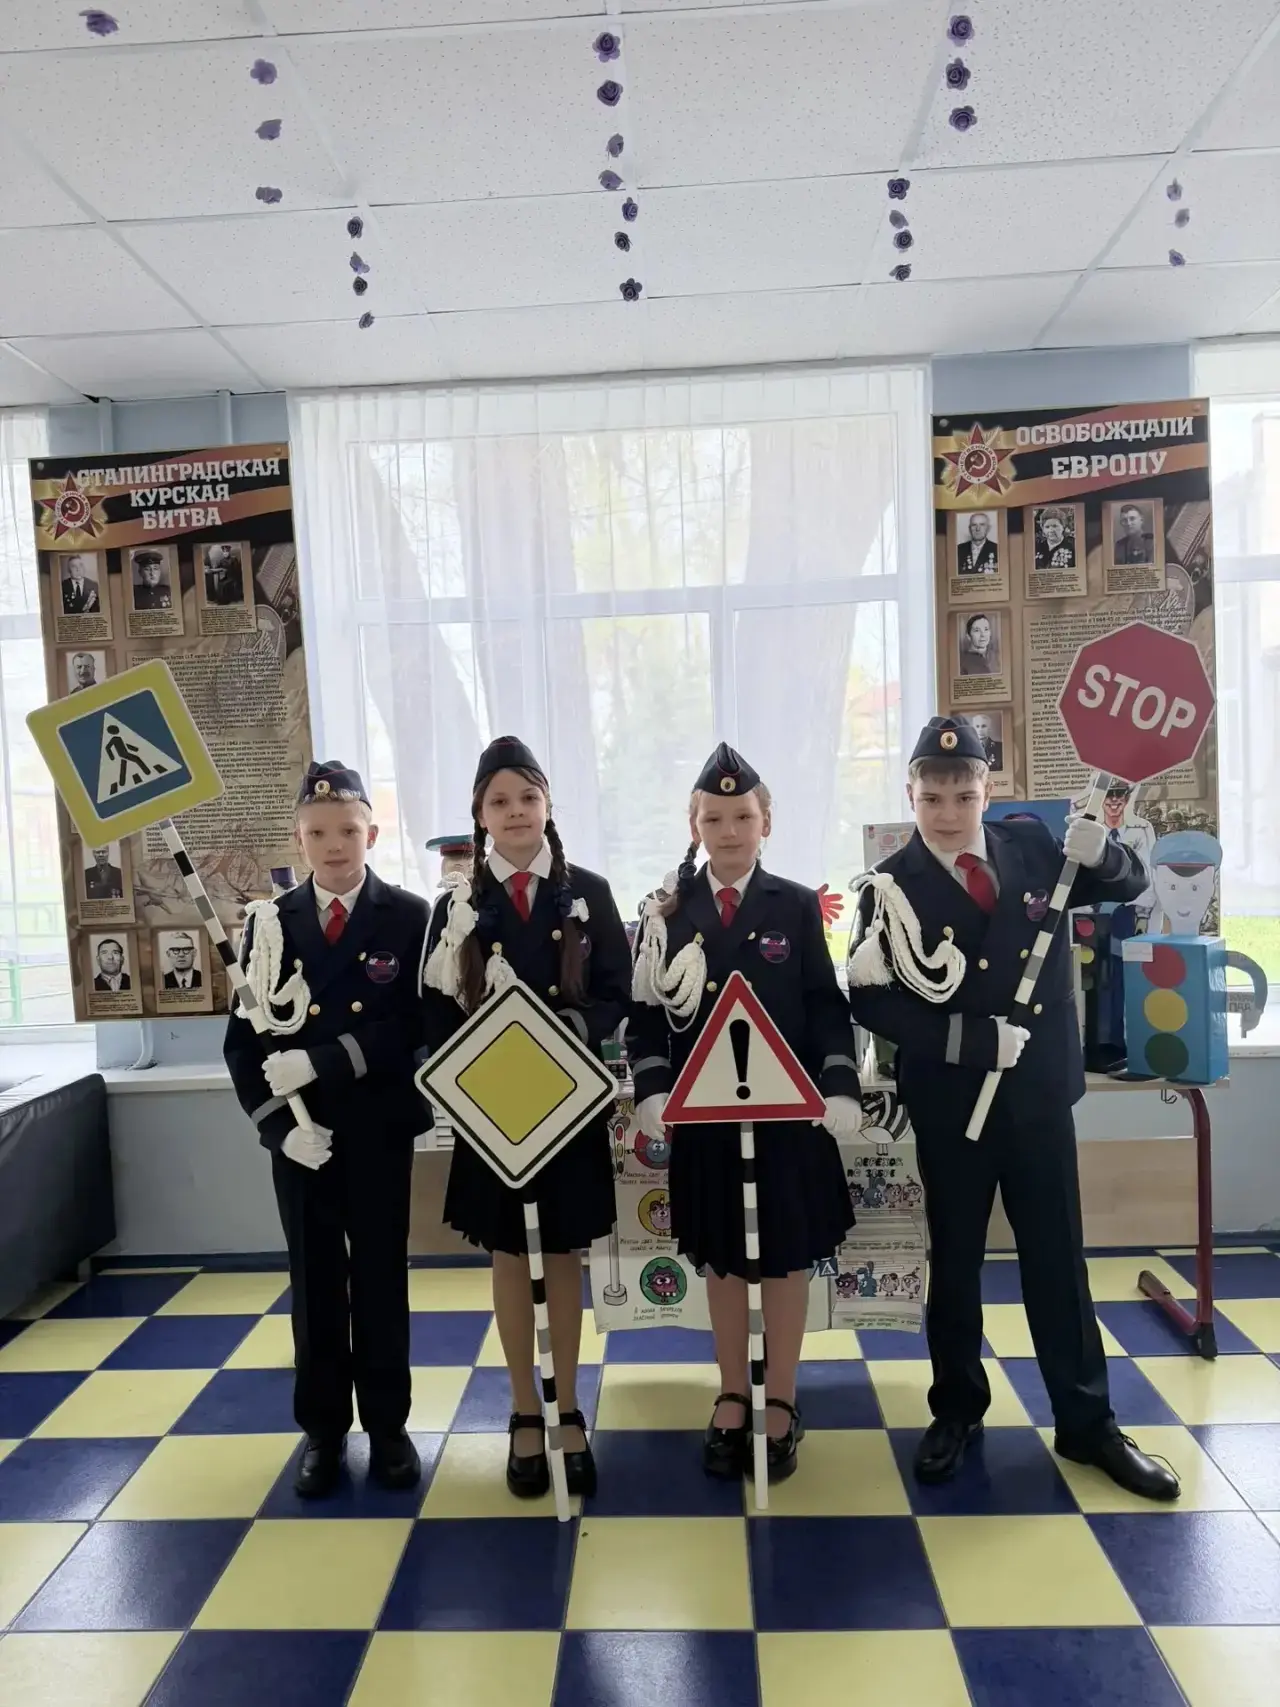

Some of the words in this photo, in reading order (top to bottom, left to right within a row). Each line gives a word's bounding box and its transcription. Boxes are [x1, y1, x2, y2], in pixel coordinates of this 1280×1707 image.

[1016, 416, 1194, 446] ОСВОБОЖДАЛИ
[77, 457, 281, 487] СТАЛИНГРАДСКАЯ
[1051, 451, 1168, 480] ЕВРОПУ
[130, 483, 230, 508] КУРСКАЯ
[142, 507, 222, 530] БИТВА
[1077, 664, 1197, 738] STOP
